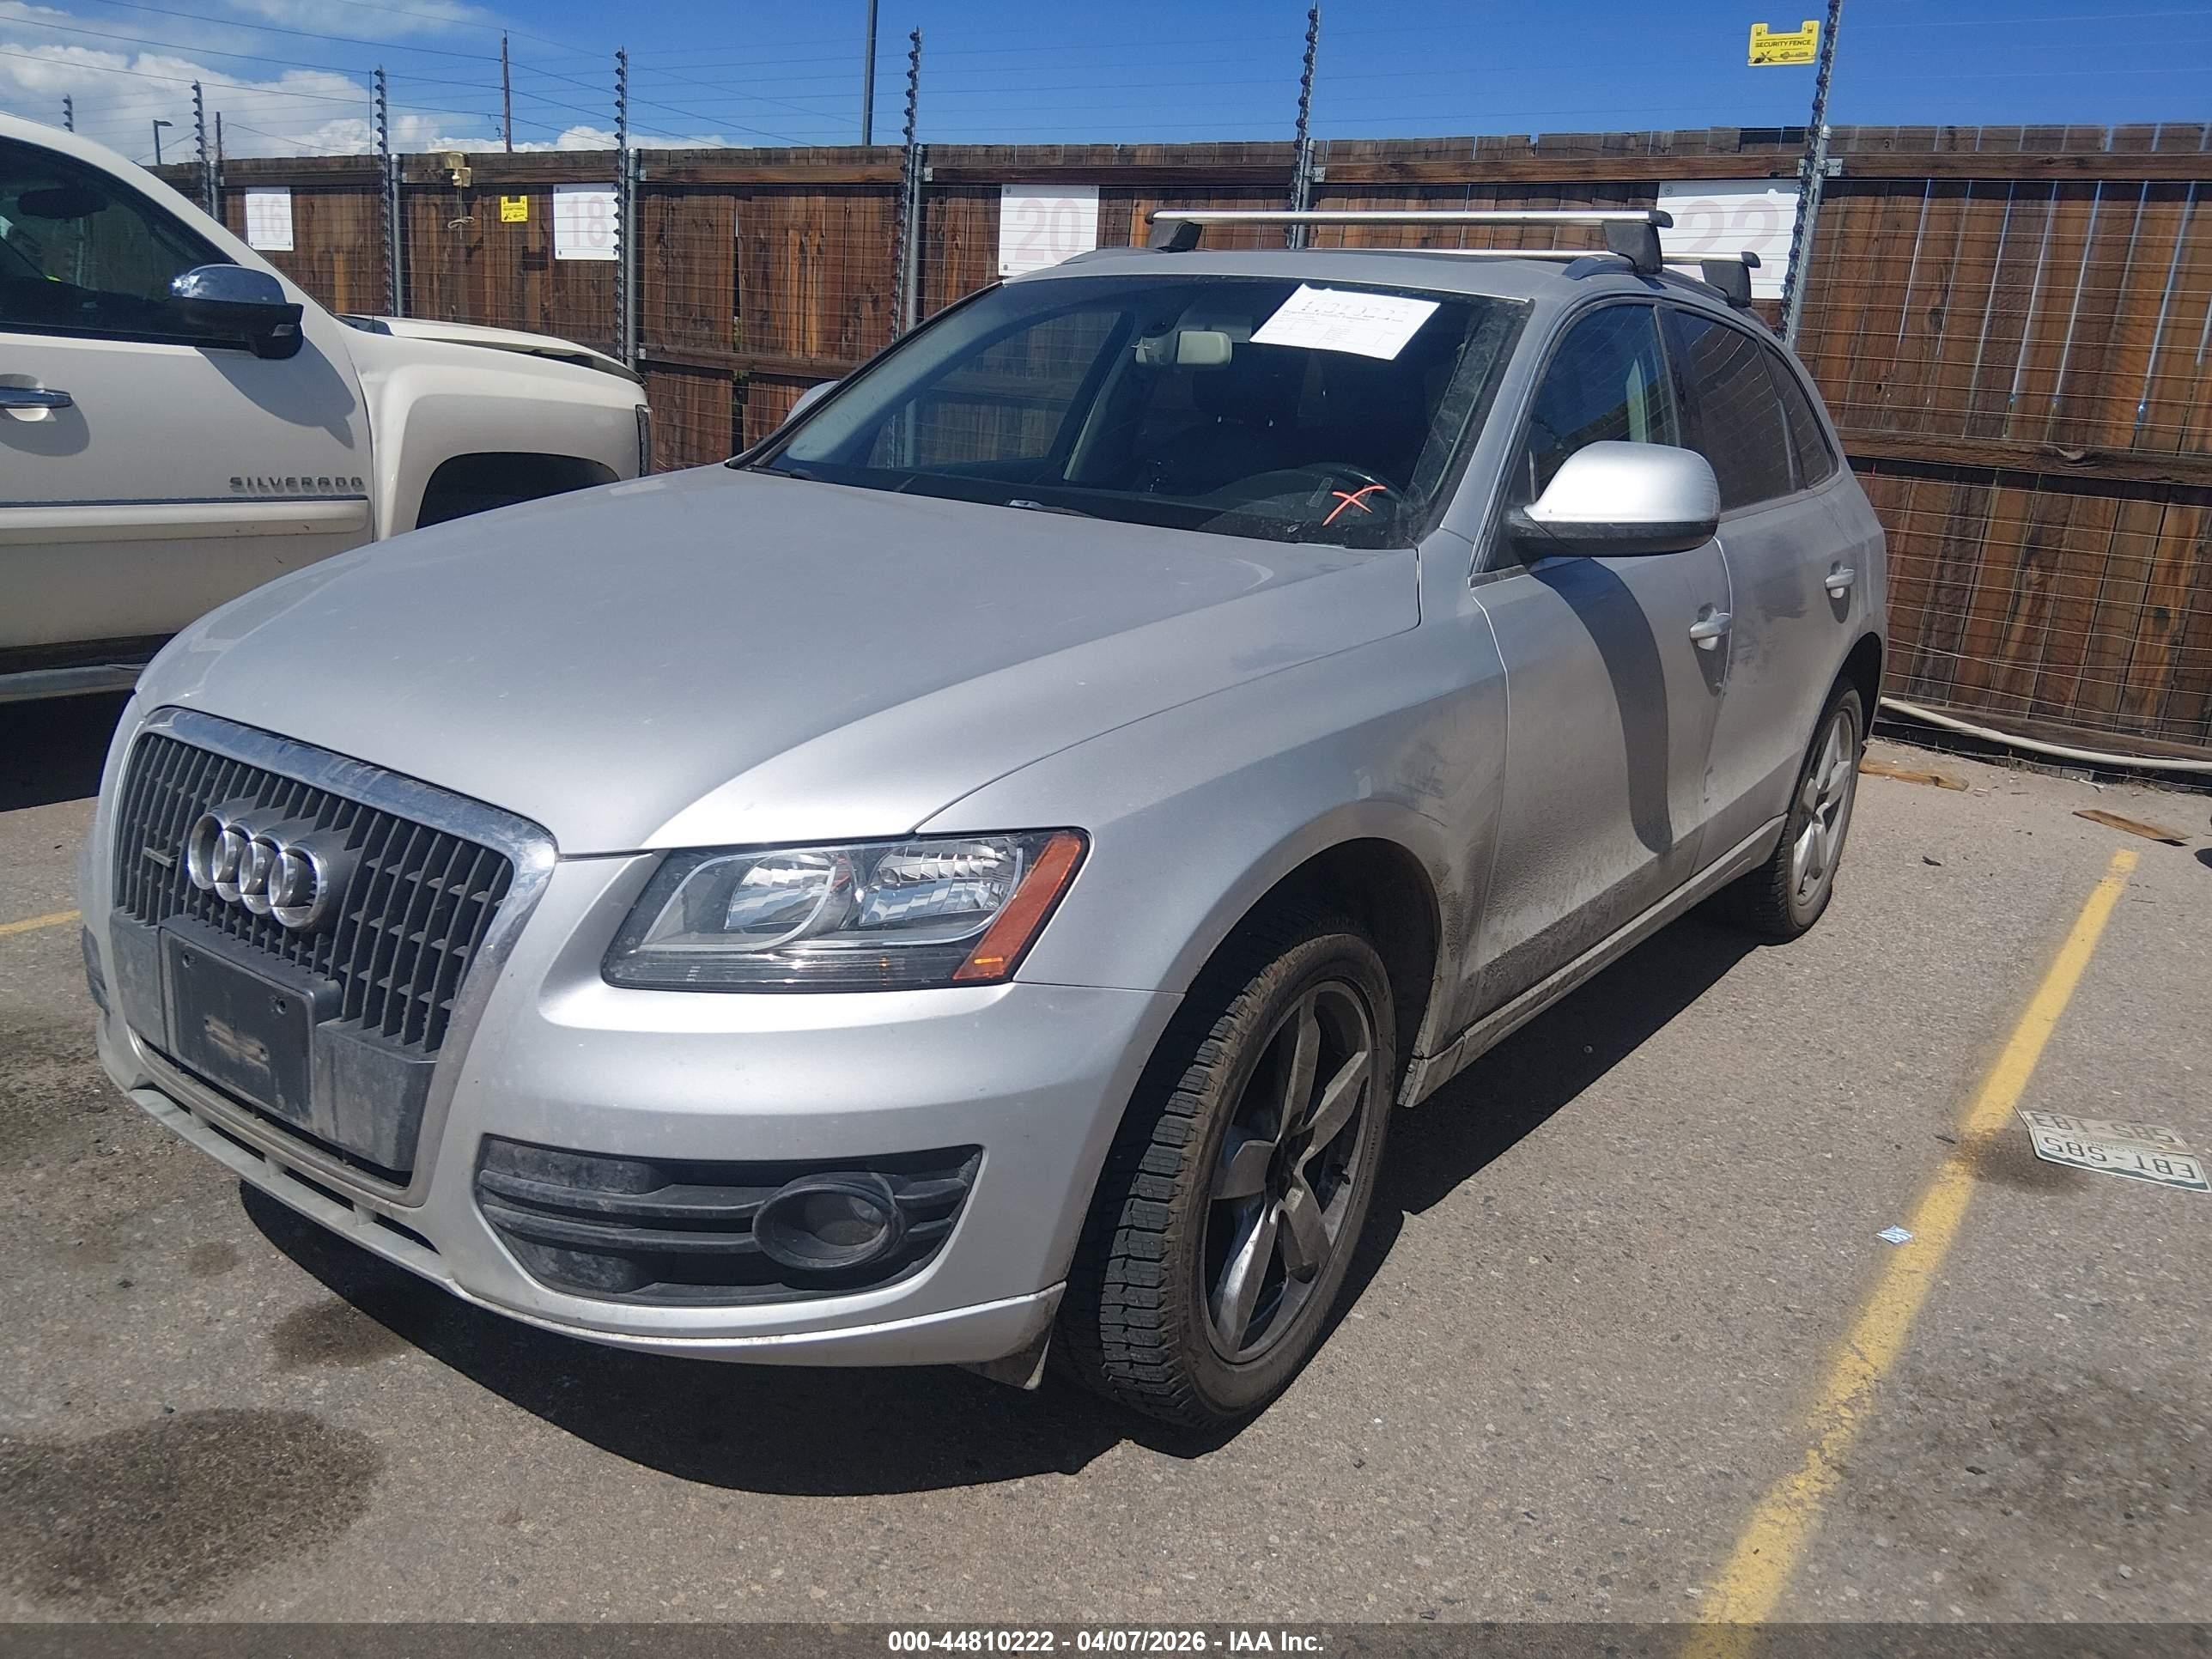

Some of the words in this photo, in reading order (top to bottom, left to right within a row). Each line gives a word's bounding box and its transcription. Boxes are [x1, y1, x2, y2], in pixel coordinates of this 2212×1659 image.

[255, 197, 284, 240] 16
[566, 196, 607, 247] 18
[1015, 198, 1080, 263] 20
[1678, 199, 1779, 278] 22
[229, 476, 362, 489] SILVERADO
